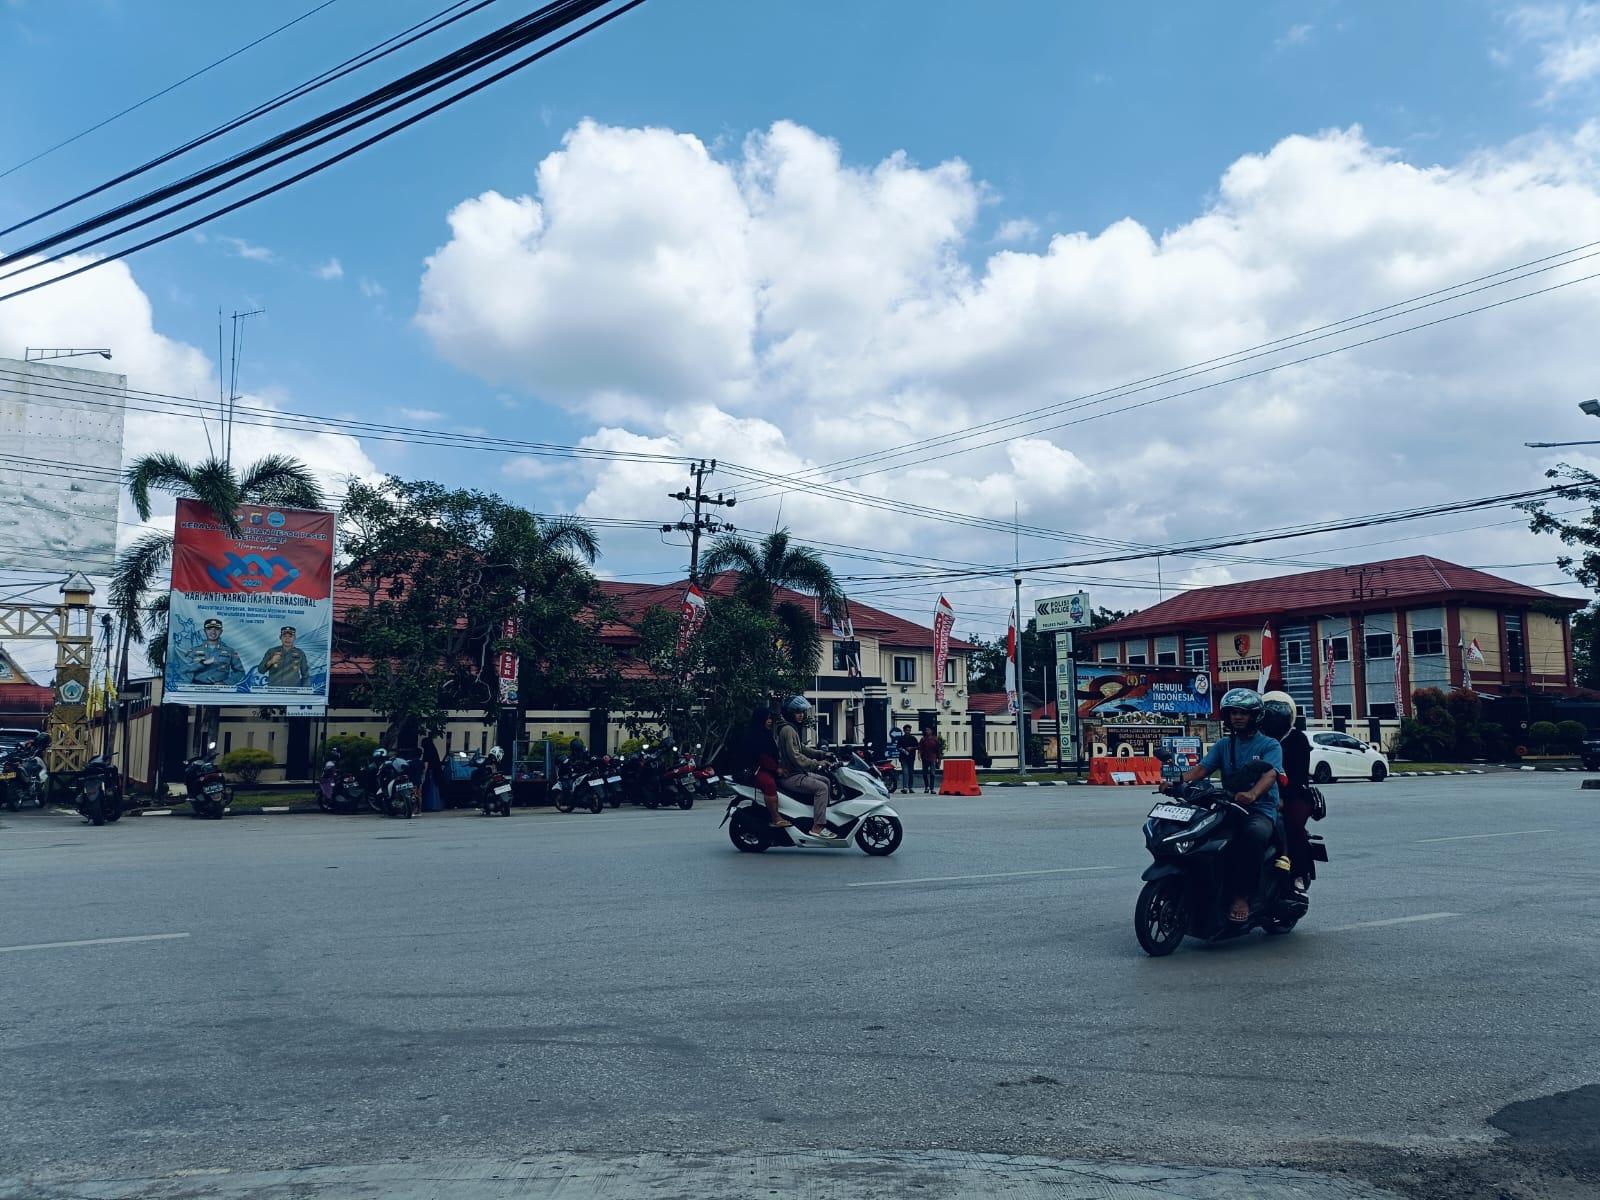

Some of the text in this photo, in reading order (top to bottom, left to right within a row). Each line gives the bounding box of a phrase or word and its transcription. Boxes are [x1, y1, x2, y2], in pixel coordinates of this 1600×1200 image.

[185, 591, 316, 608] HARI ANTI NARKOTIKA INTERNASIONAL
[1050, 599, 1070, 608] POLISI
[1050, 605, 1070, 615] POLICE
[1152, 682, 1183, 693] MENUJU
[1152, 692, 1195, 702] INDONESIA
[1153, 702, 1175, 711] EMAS
